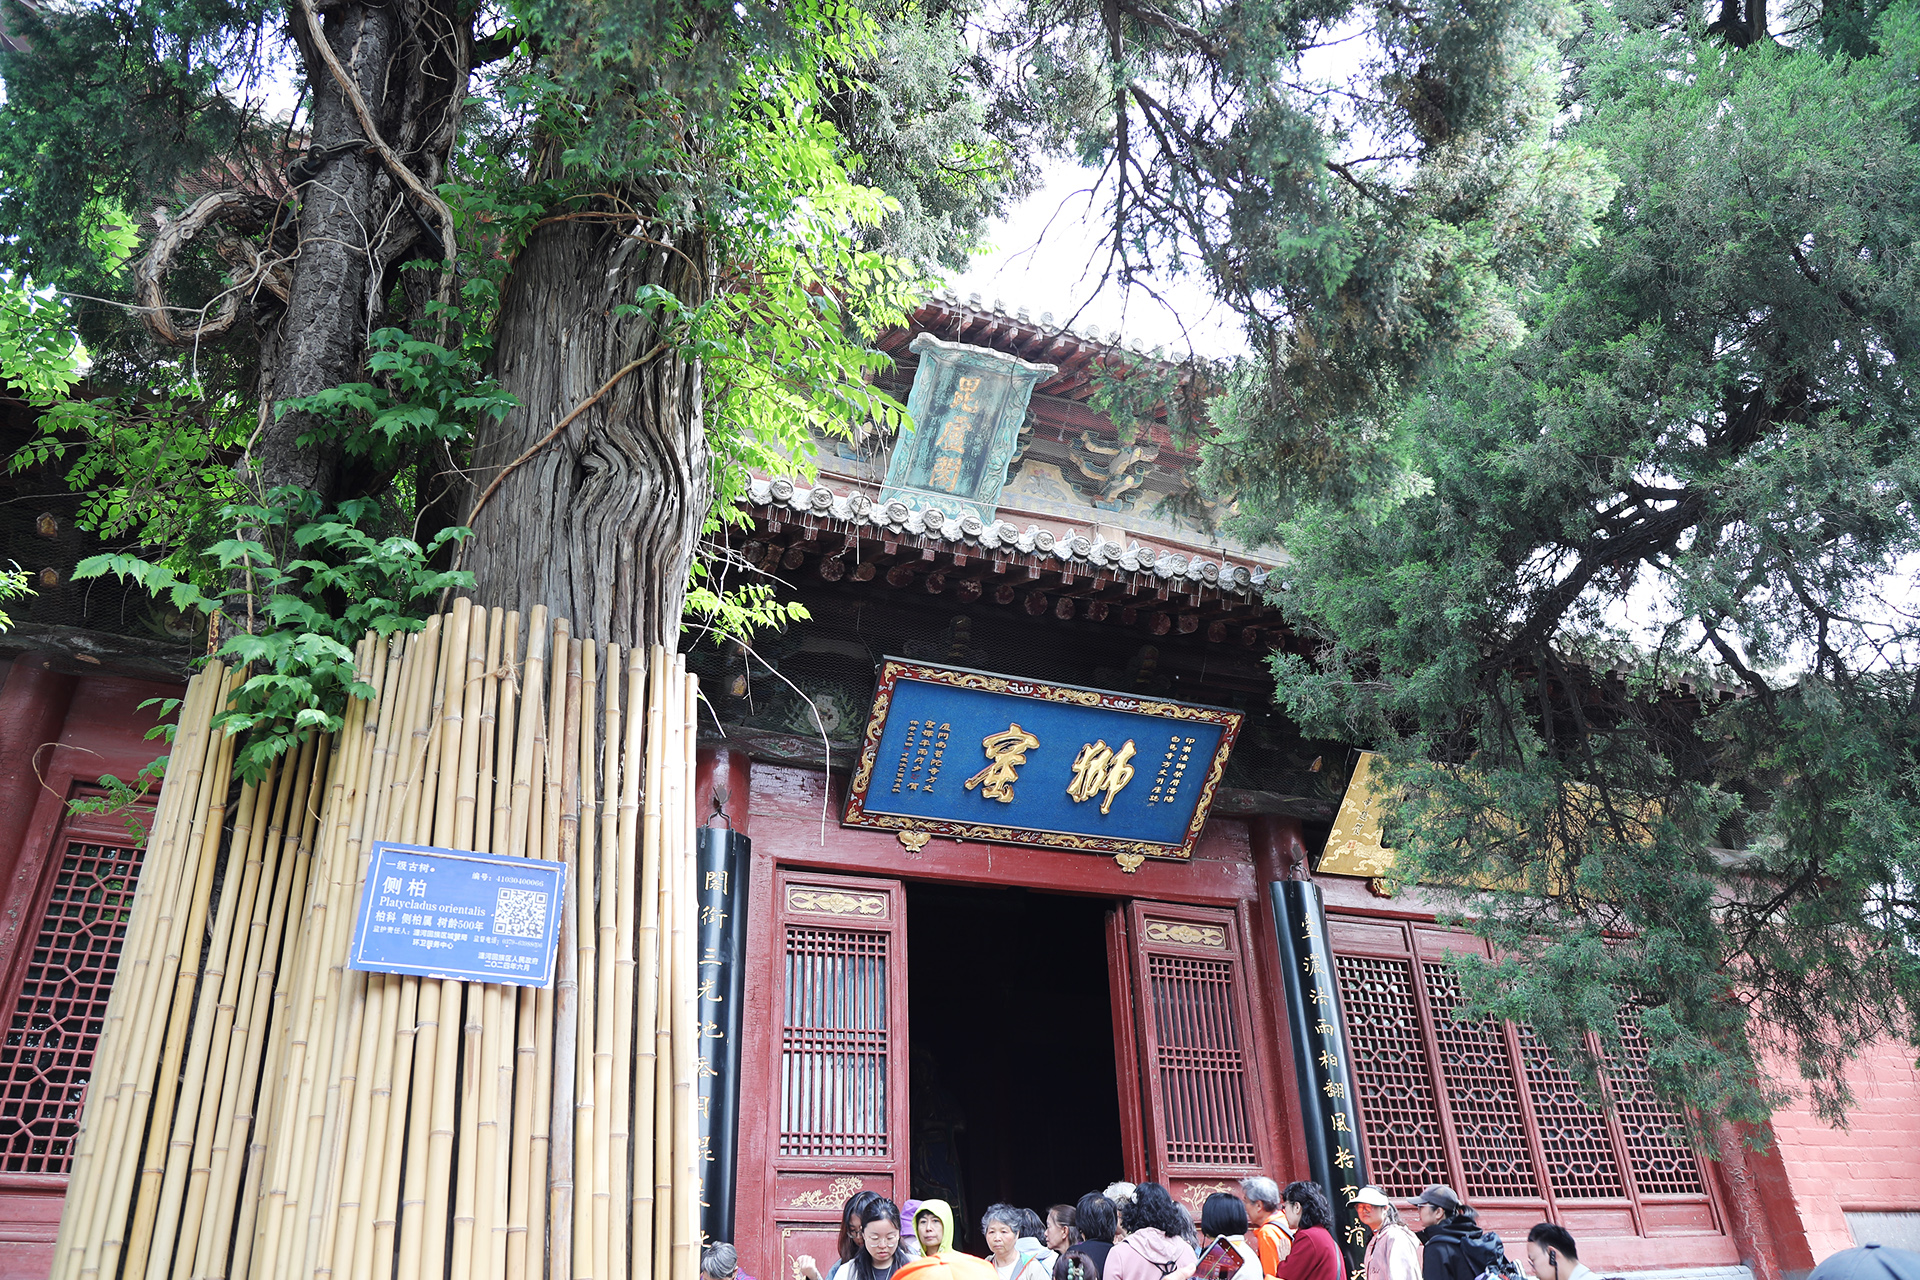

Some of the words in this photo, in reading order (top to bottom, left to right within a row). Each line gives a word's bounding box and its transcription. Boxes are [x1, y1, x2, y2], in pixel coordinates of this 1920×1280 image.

[385, 860, 430, 873] 一级古树
[382, 876, 427, 898] 侧柏
[379, 896, 437, 911] Platycladus
[438, 903, 486, 917] orientalis
[375, 910, 396, 923] 柏科
[401, 913, 433, 927] 侧柏属
[437, 916, 484, 932] 树龄500年
